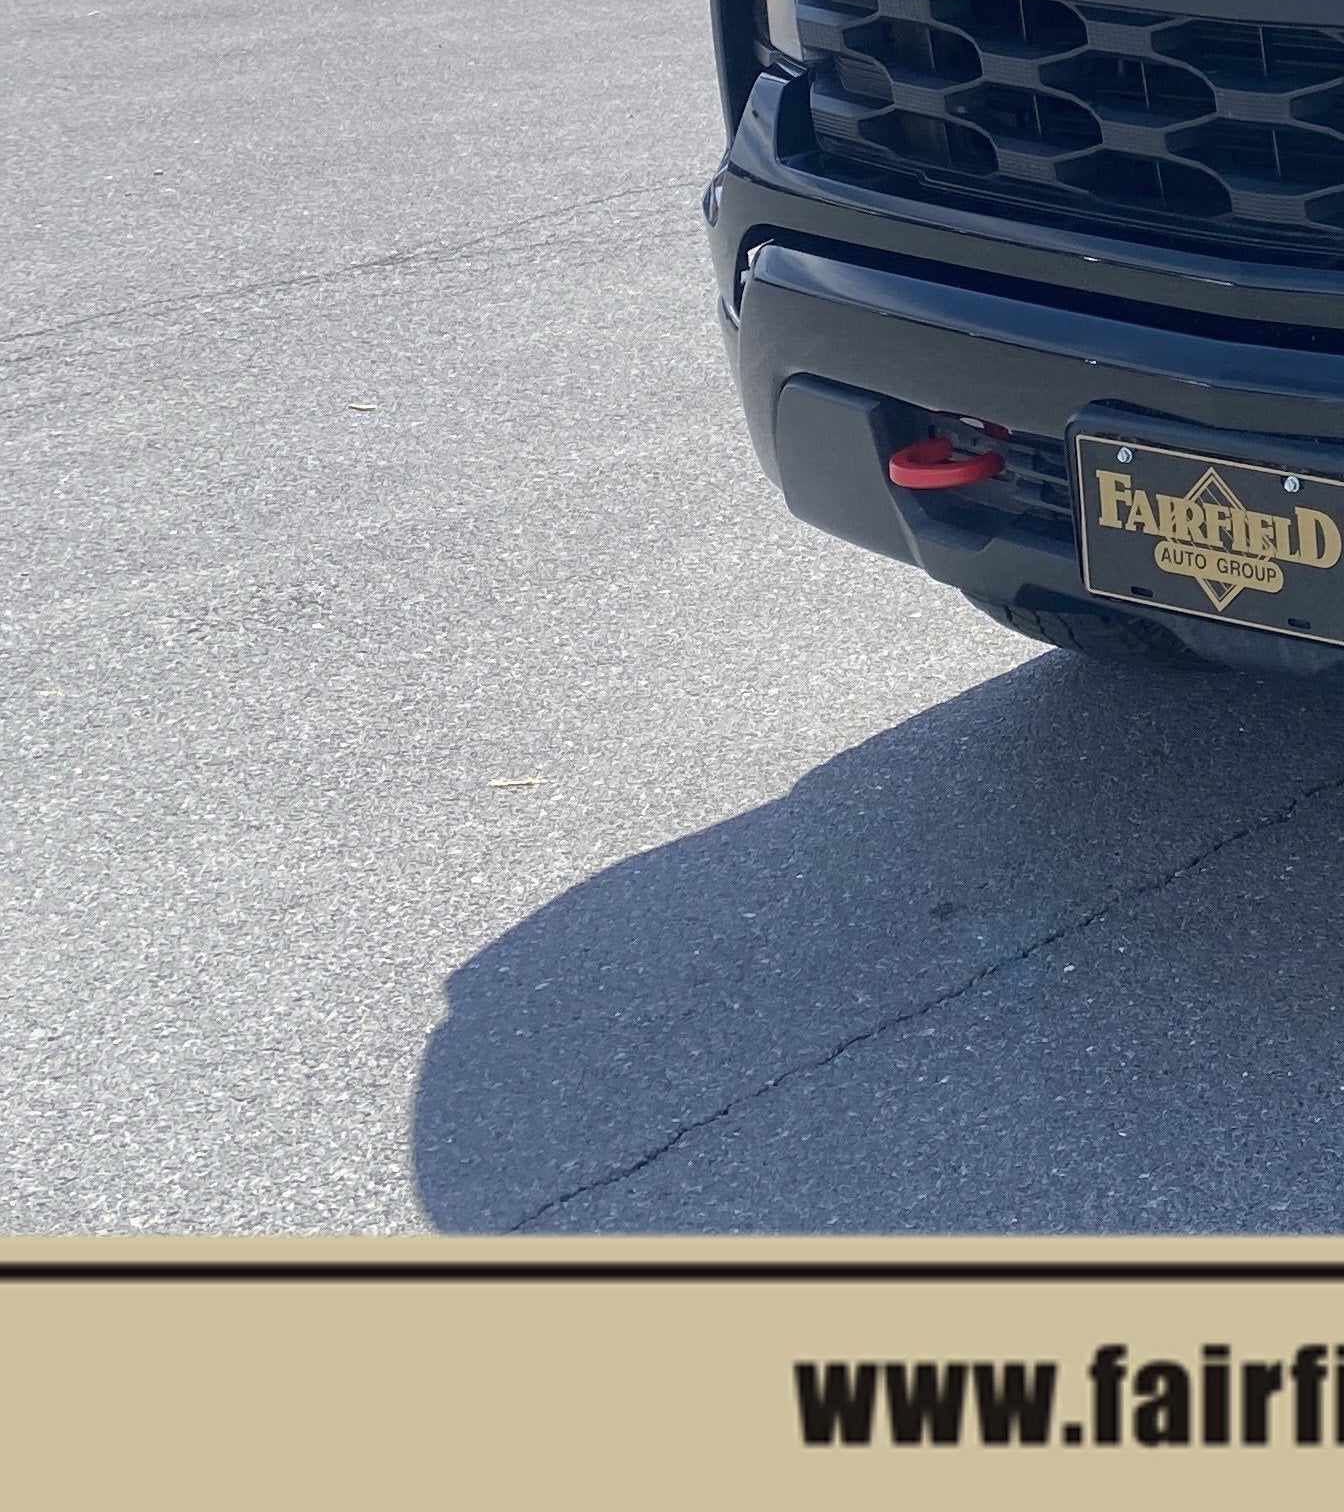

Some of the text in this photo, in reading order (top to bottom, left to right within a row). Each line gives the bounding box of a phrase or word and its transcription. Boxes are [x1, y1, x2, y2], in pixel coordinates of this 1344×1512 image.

[1095, 469, 1342, 569] FAIRFIELD
[1160, 546, 1279, 585] AUTO GROUP
